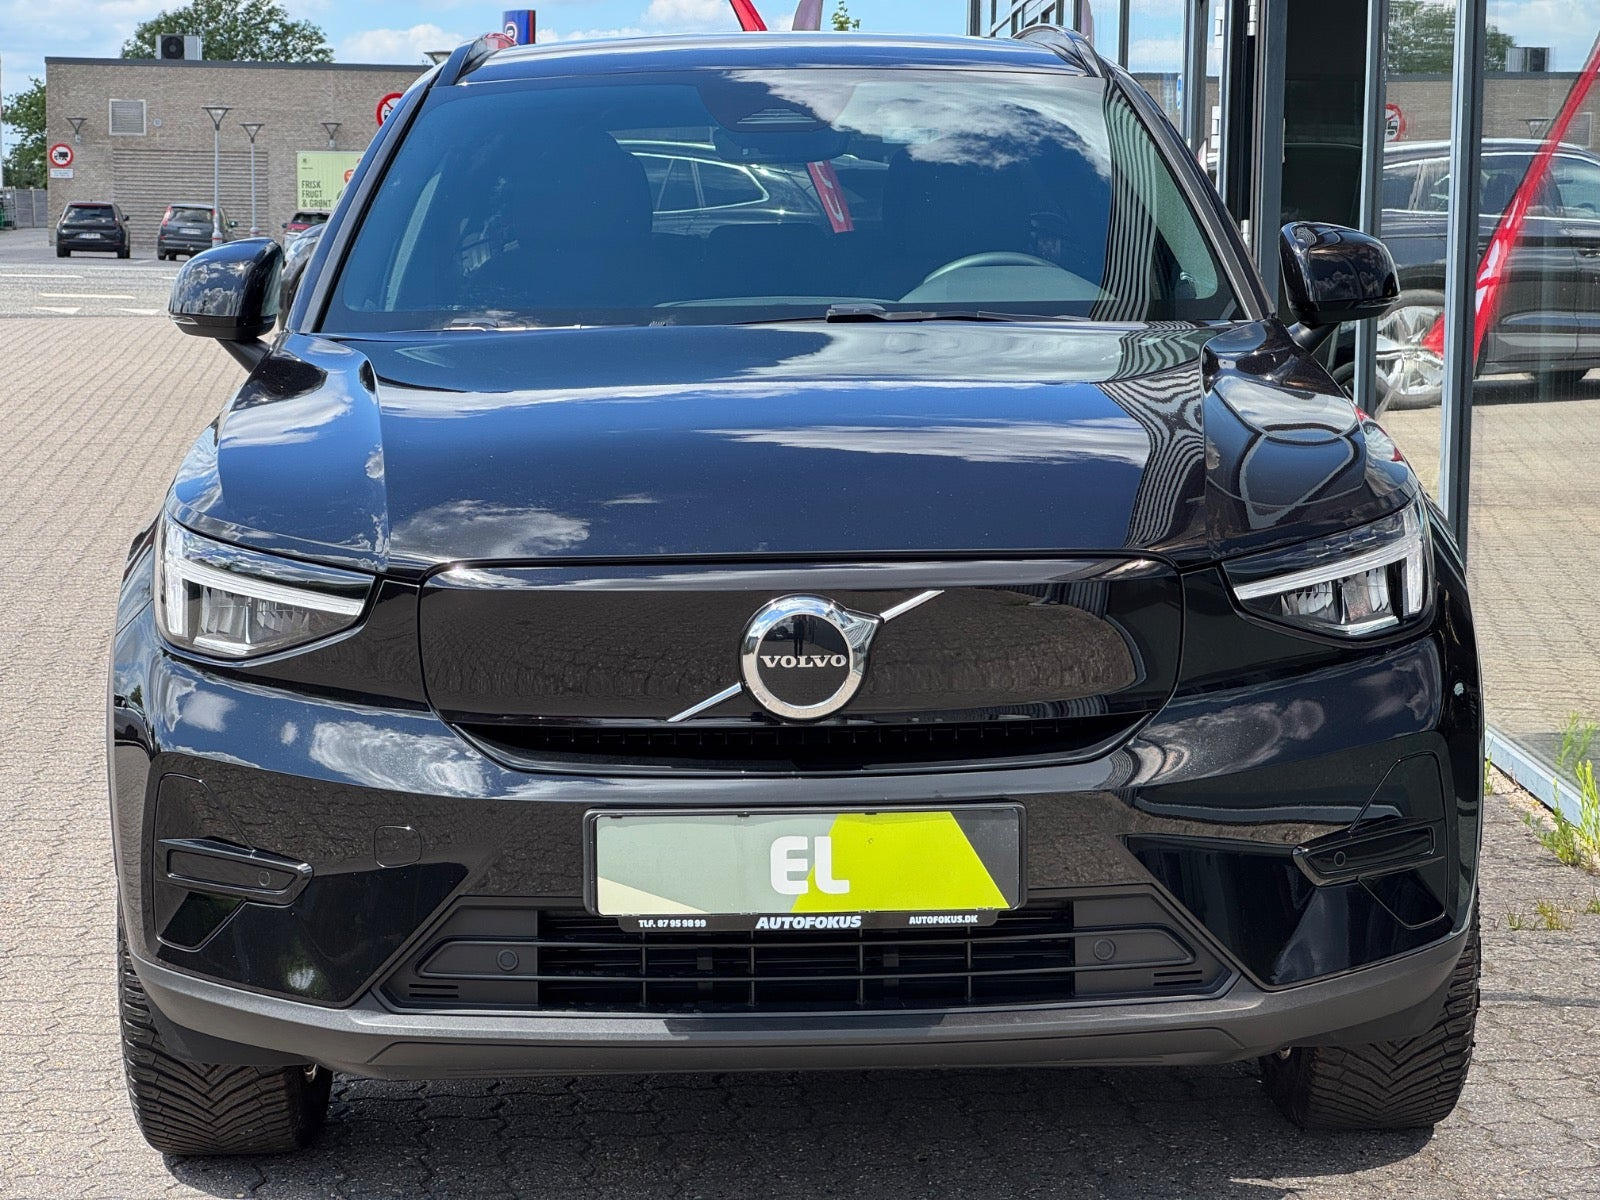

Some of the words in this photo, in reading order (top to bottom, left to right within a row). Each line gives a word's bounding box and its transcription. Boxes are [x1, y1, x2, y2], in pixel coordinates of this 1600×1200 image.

[301, 180, 321, 189] FRISK
[301, 190, 322, 198] FRUGT
[301, 199, 308, 208] &
[760, 654, 847, 668] VOLVO
[770, 835, 850, 895] EL
[638, 919, 656, 928] TLF.
[657, 919, 668, 928] 87
[669, 919, 681, 928] 95
[682, 919, 693, 928] 98
[694, 919, 706, 928] 99
[755, 915, 862, 930] AUTOFOKUS
[909, 914, 978, 925] AUTOFOKUS.DK
